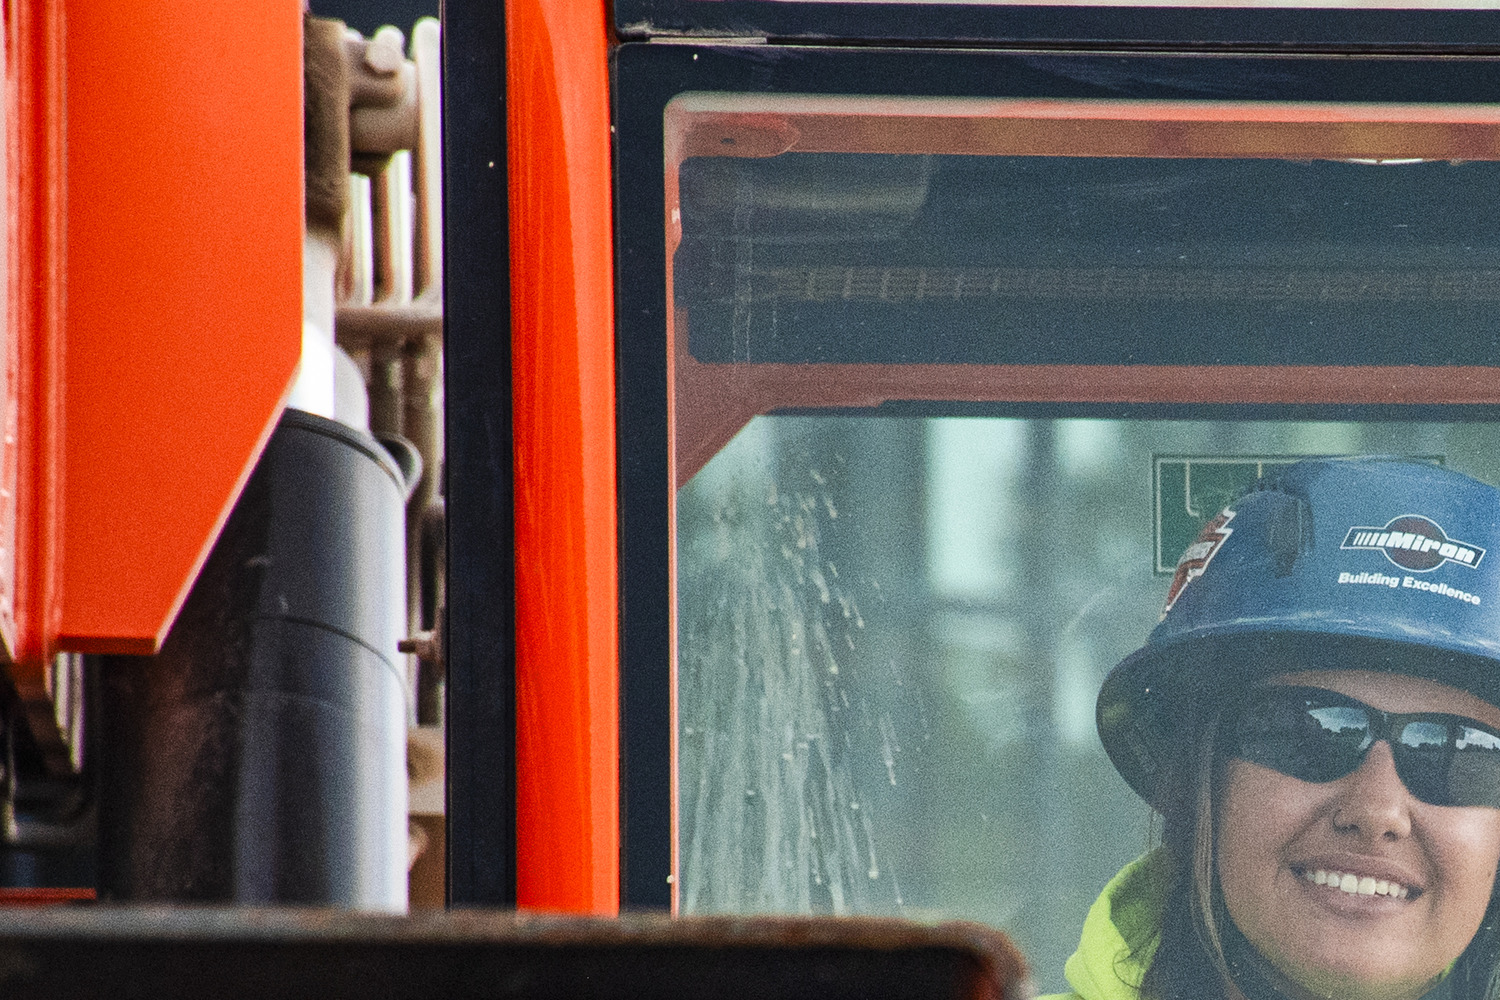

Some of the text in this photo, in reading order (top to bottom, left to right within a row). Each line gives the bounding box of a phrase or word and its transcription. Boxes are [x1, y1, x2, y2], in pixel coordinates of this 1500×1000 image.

[1385, 531, 1476, 564] Miron
[1338, 572, 1481, 606] Building Excellence
